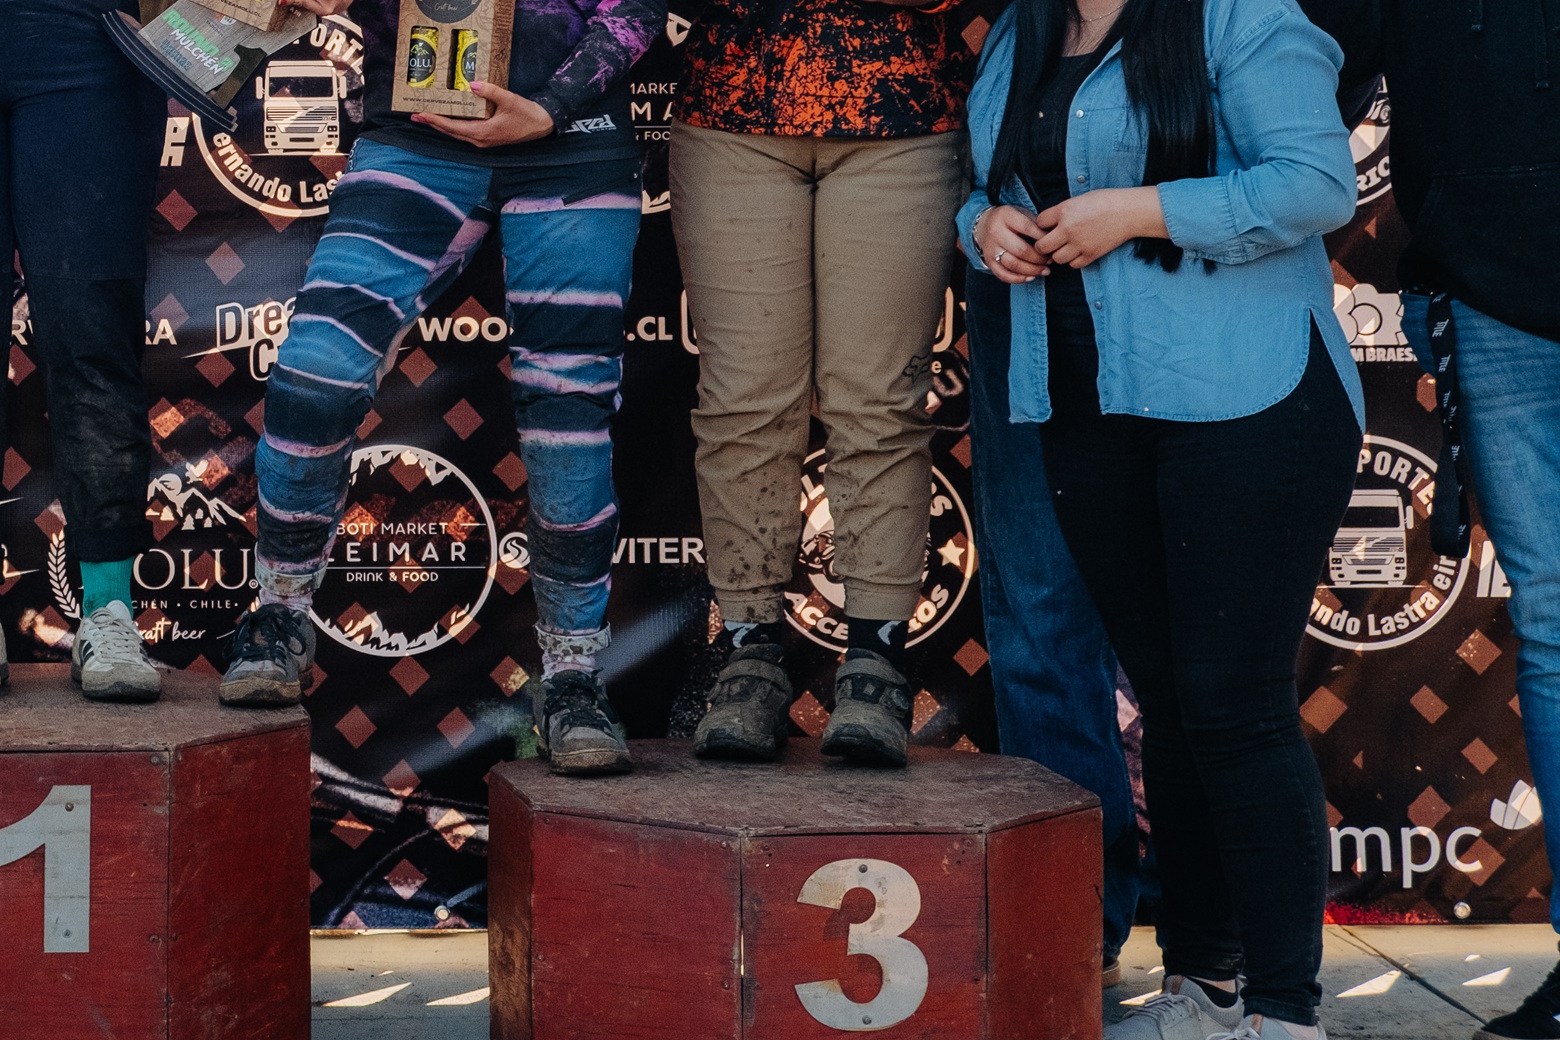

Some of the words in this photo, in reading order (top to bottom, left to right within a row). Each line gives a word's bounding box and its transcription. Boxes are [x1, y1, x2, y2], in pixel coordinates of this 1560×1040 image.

[171, 28, 225, 75] MULCHÉN
[213, 132, 292, 202] ernando
[381, 522, 449, 536] MARKET
[326, 542, 468, 562] EIMAR
[613, 537, 705, 564] VITER
[132, 548, 252, 591] OLU
[388, 572, 398, 583] &
[402, 572, 439, 583] FOOD
[131, 597, 169, 610] CHÉN
[190, 599, 232, 610] CHILE
[1367, 591, 1441, 637] Lastra
[139, 617, 171, 644] raft
[172, 620, 206, 642] beer
[1330, 826, 1484, 889] mpc
[794, 858, 929, 1032] 3
